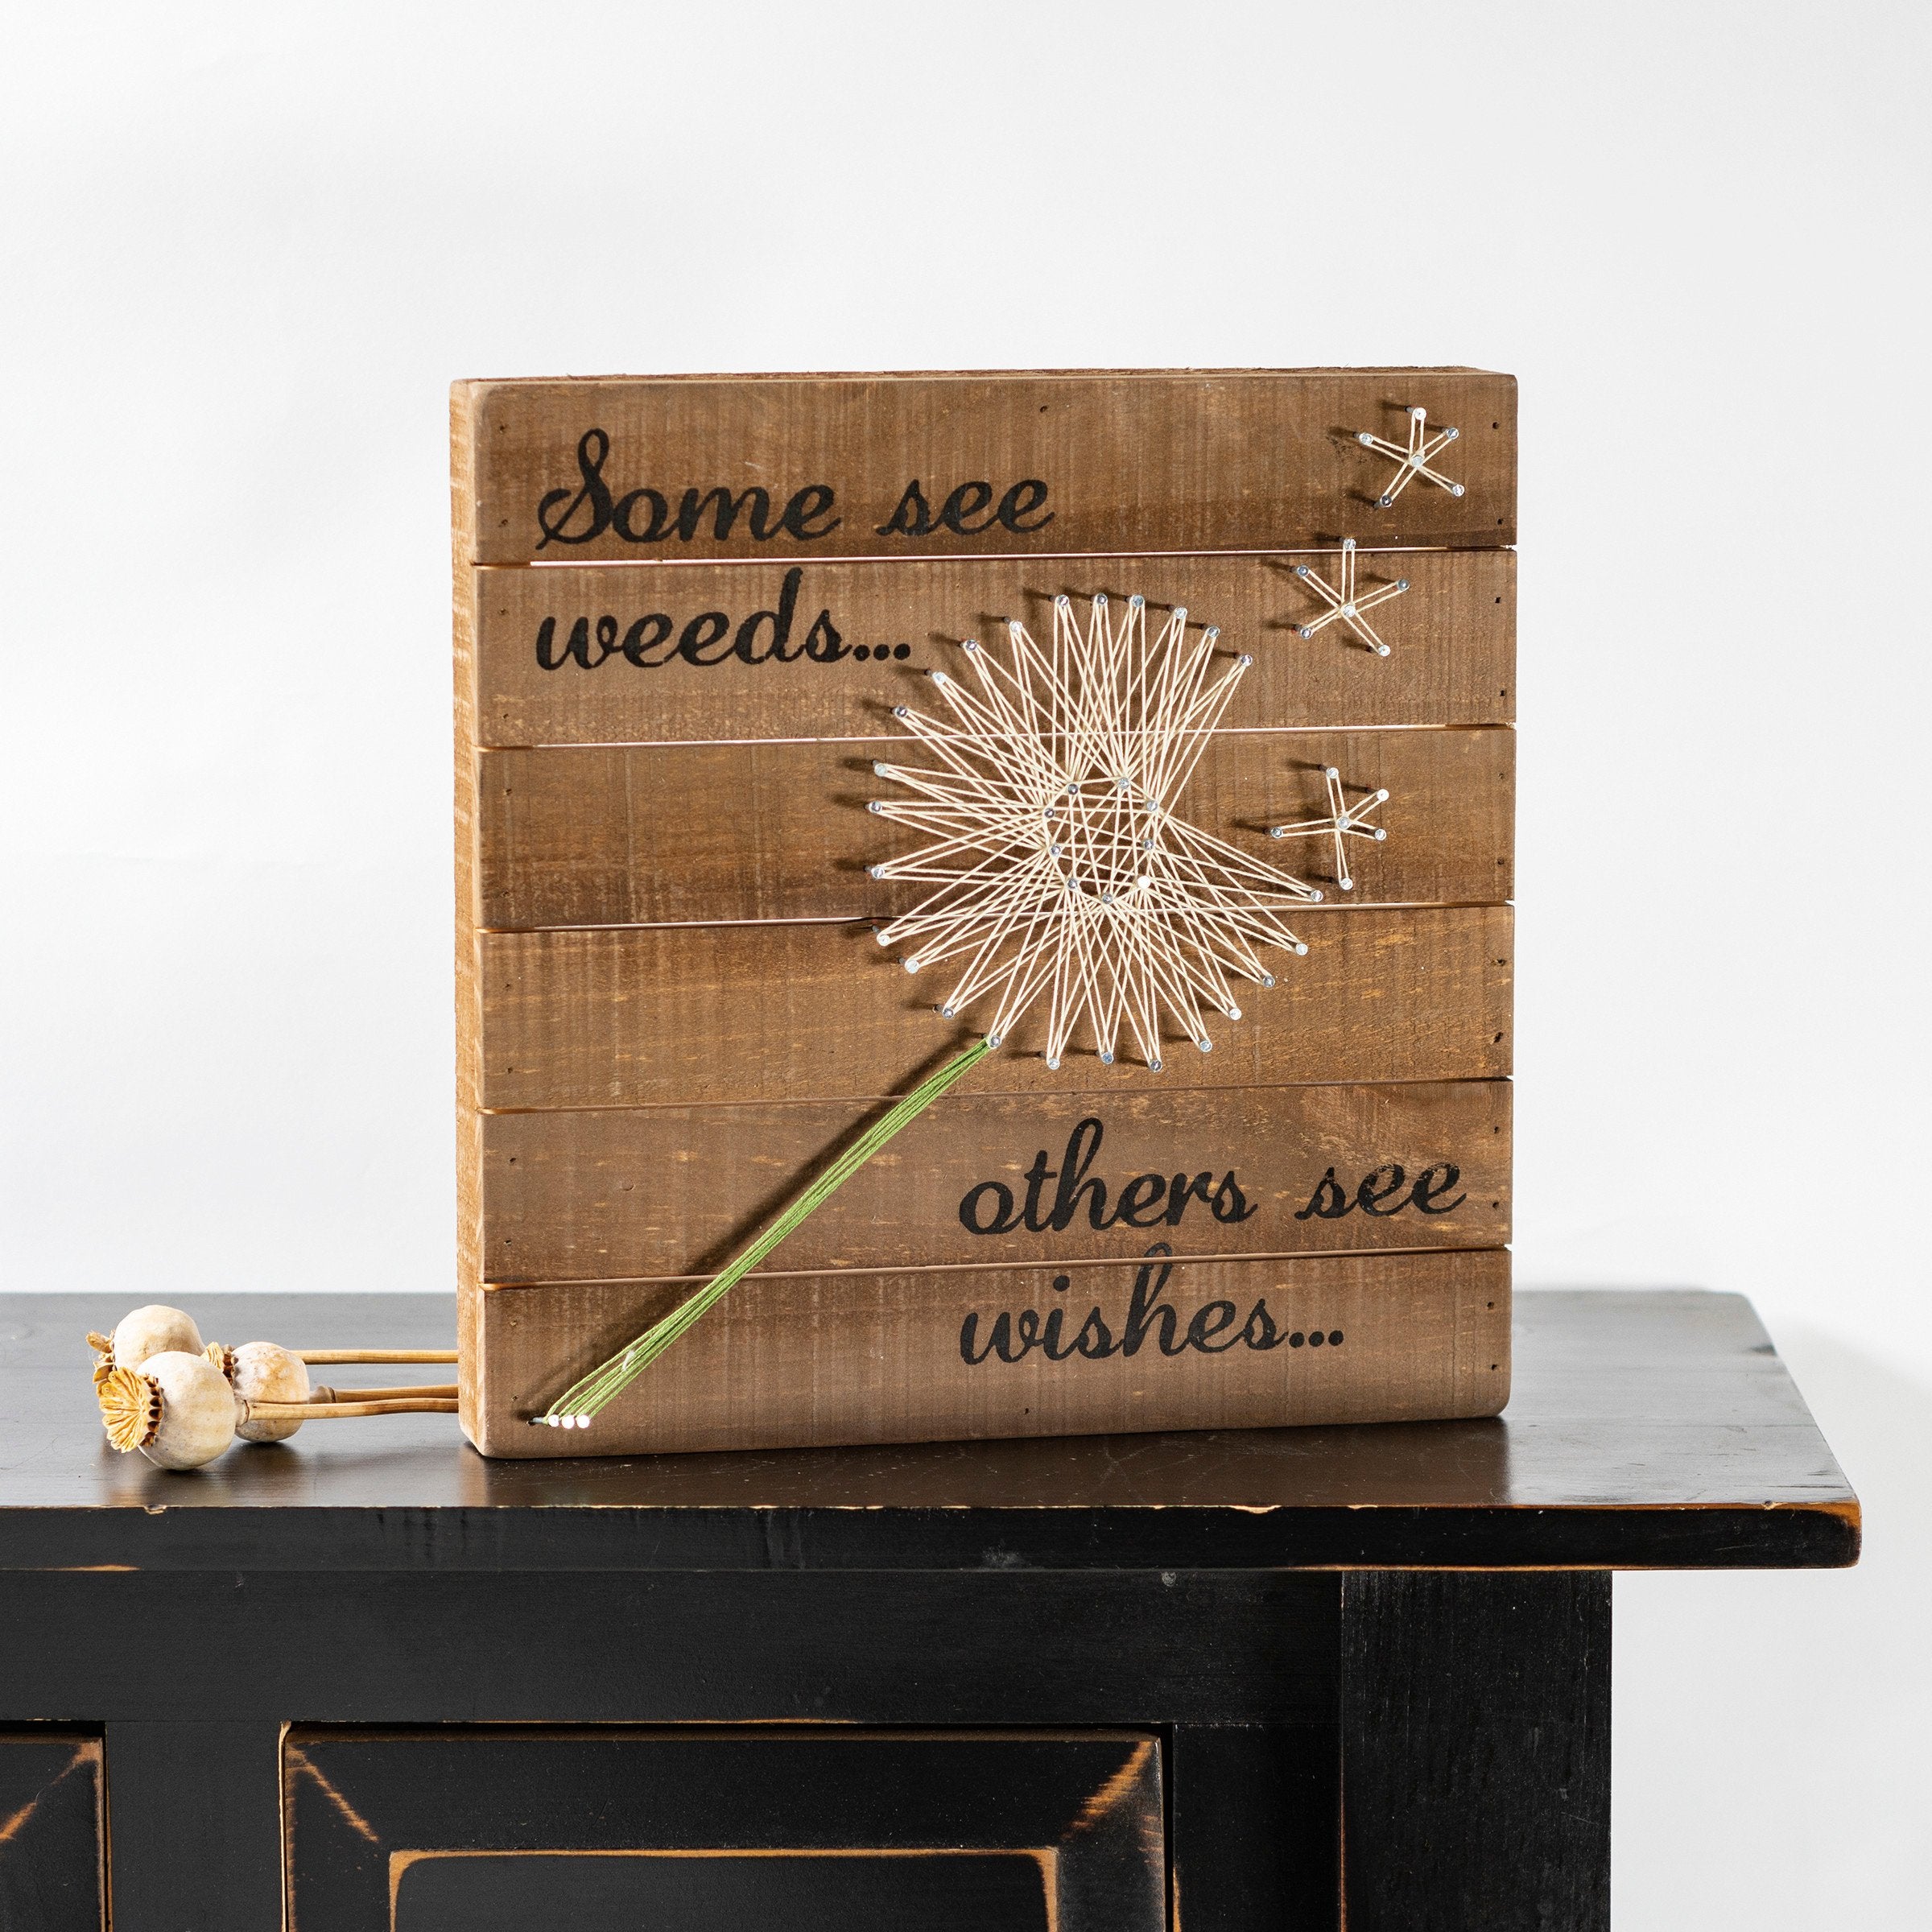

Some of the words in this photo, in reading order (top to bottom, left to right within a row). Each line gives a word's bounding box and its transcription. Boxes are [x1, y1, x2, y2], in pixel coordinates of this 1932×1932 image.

[535, 427, 842, 551] Some
[875, 478, 1055, 538] see
[535, 567, 911, 671] weeds...
[958, 1117, 1258, 1236] others
[1294, 1160, 1467, 1220] see
[960, 1241, 1344, 1365] wishes...
